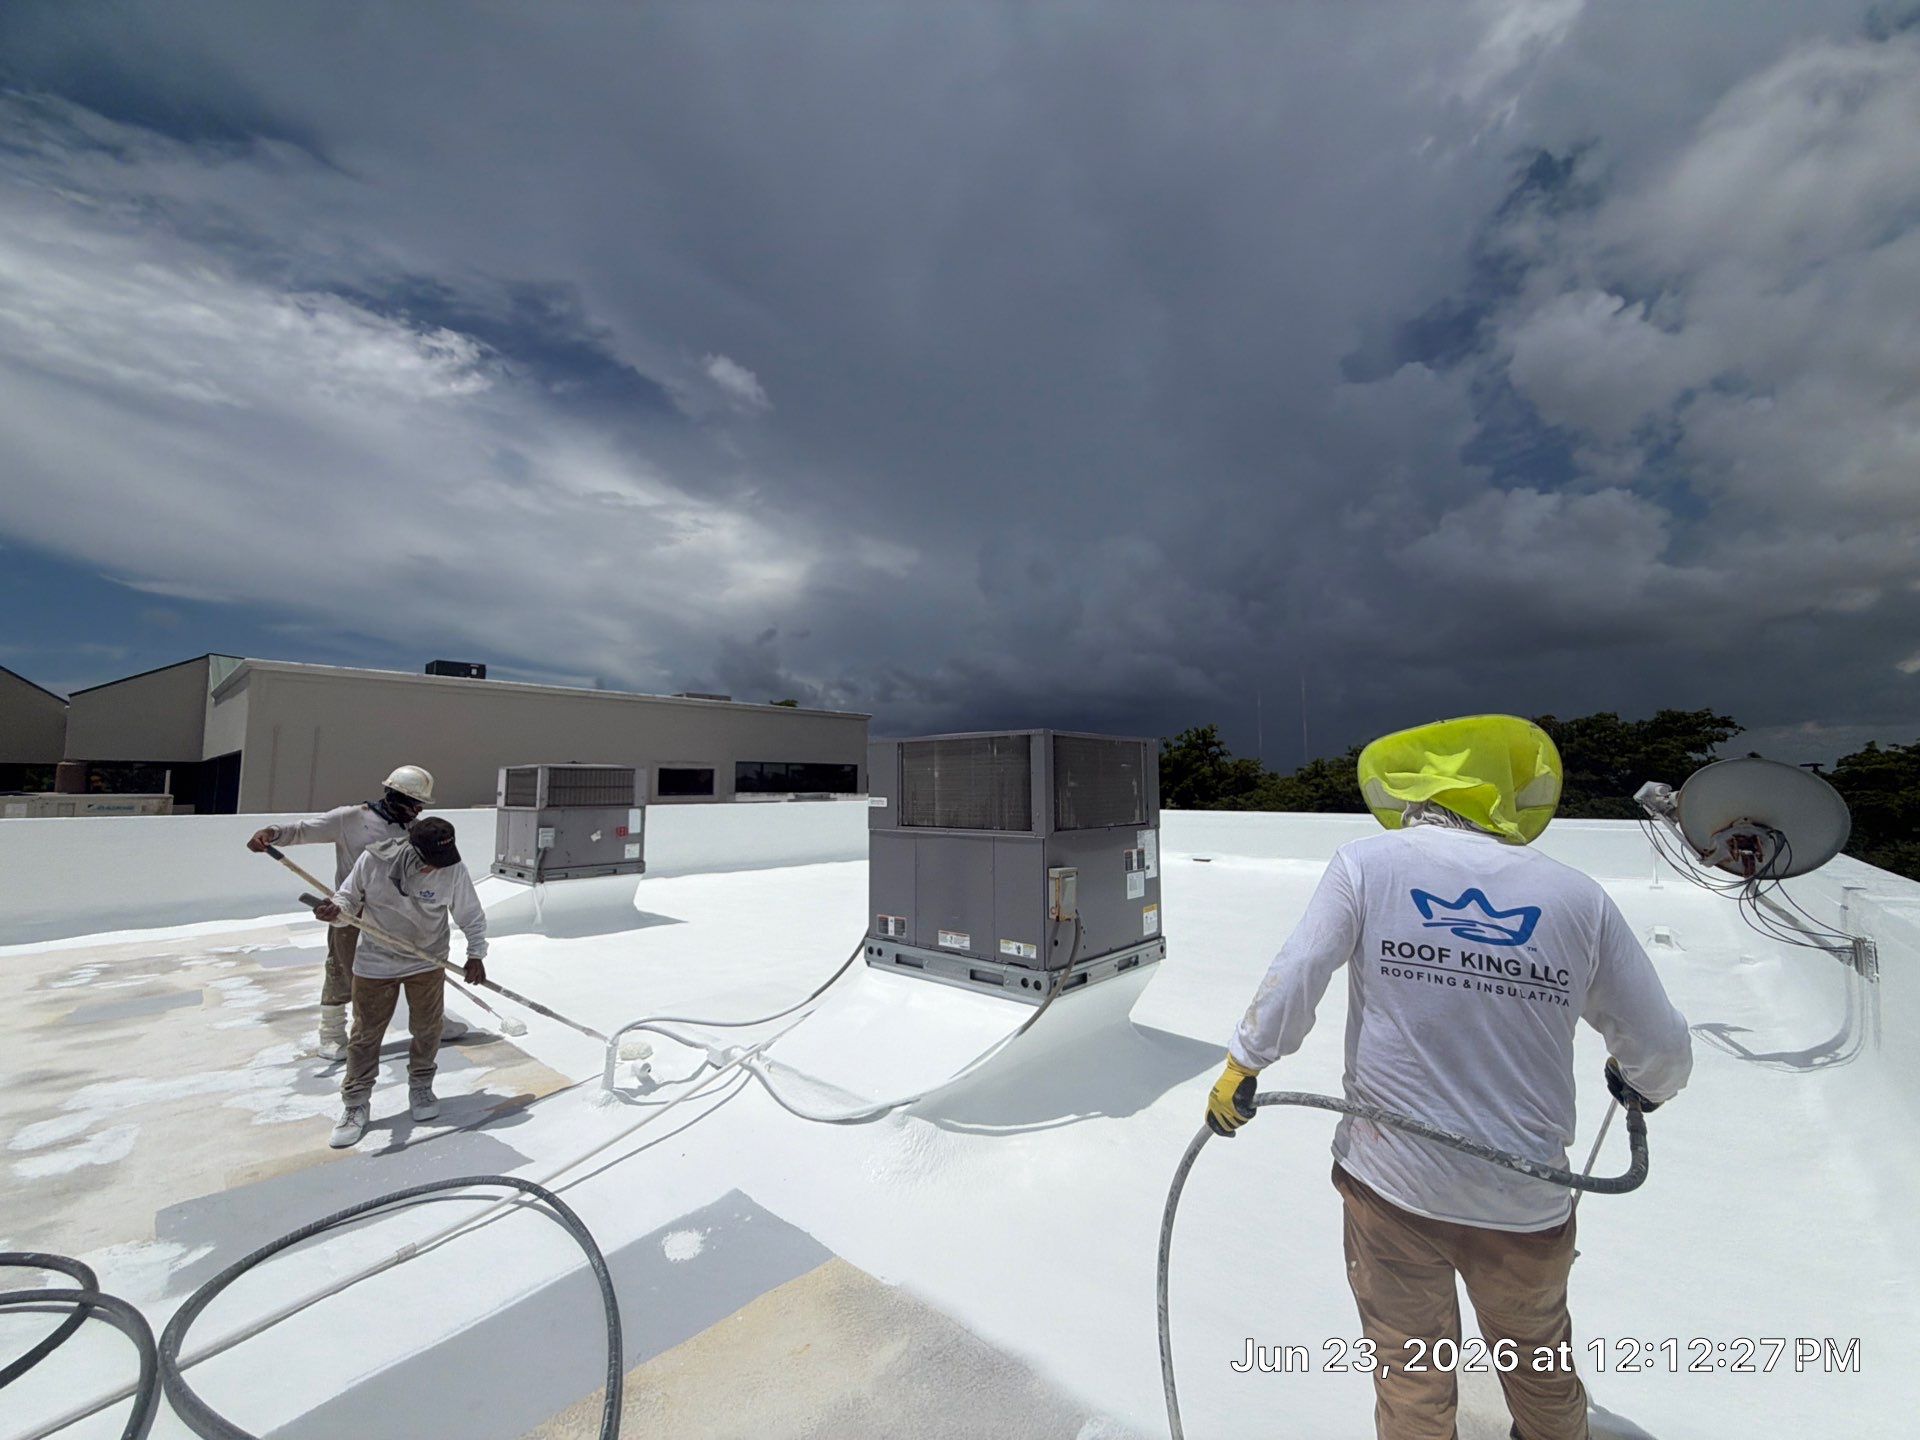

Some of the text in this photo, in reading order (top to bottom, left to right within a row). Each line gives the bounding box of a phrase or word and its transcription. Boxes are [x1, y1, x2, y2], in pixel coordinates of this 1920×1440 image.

[1381, 940, 1569, 987] ROOF KING LLC
[1381, 966, 1456, 987] ROOFING
[1463, 979, 1471, 989] &
